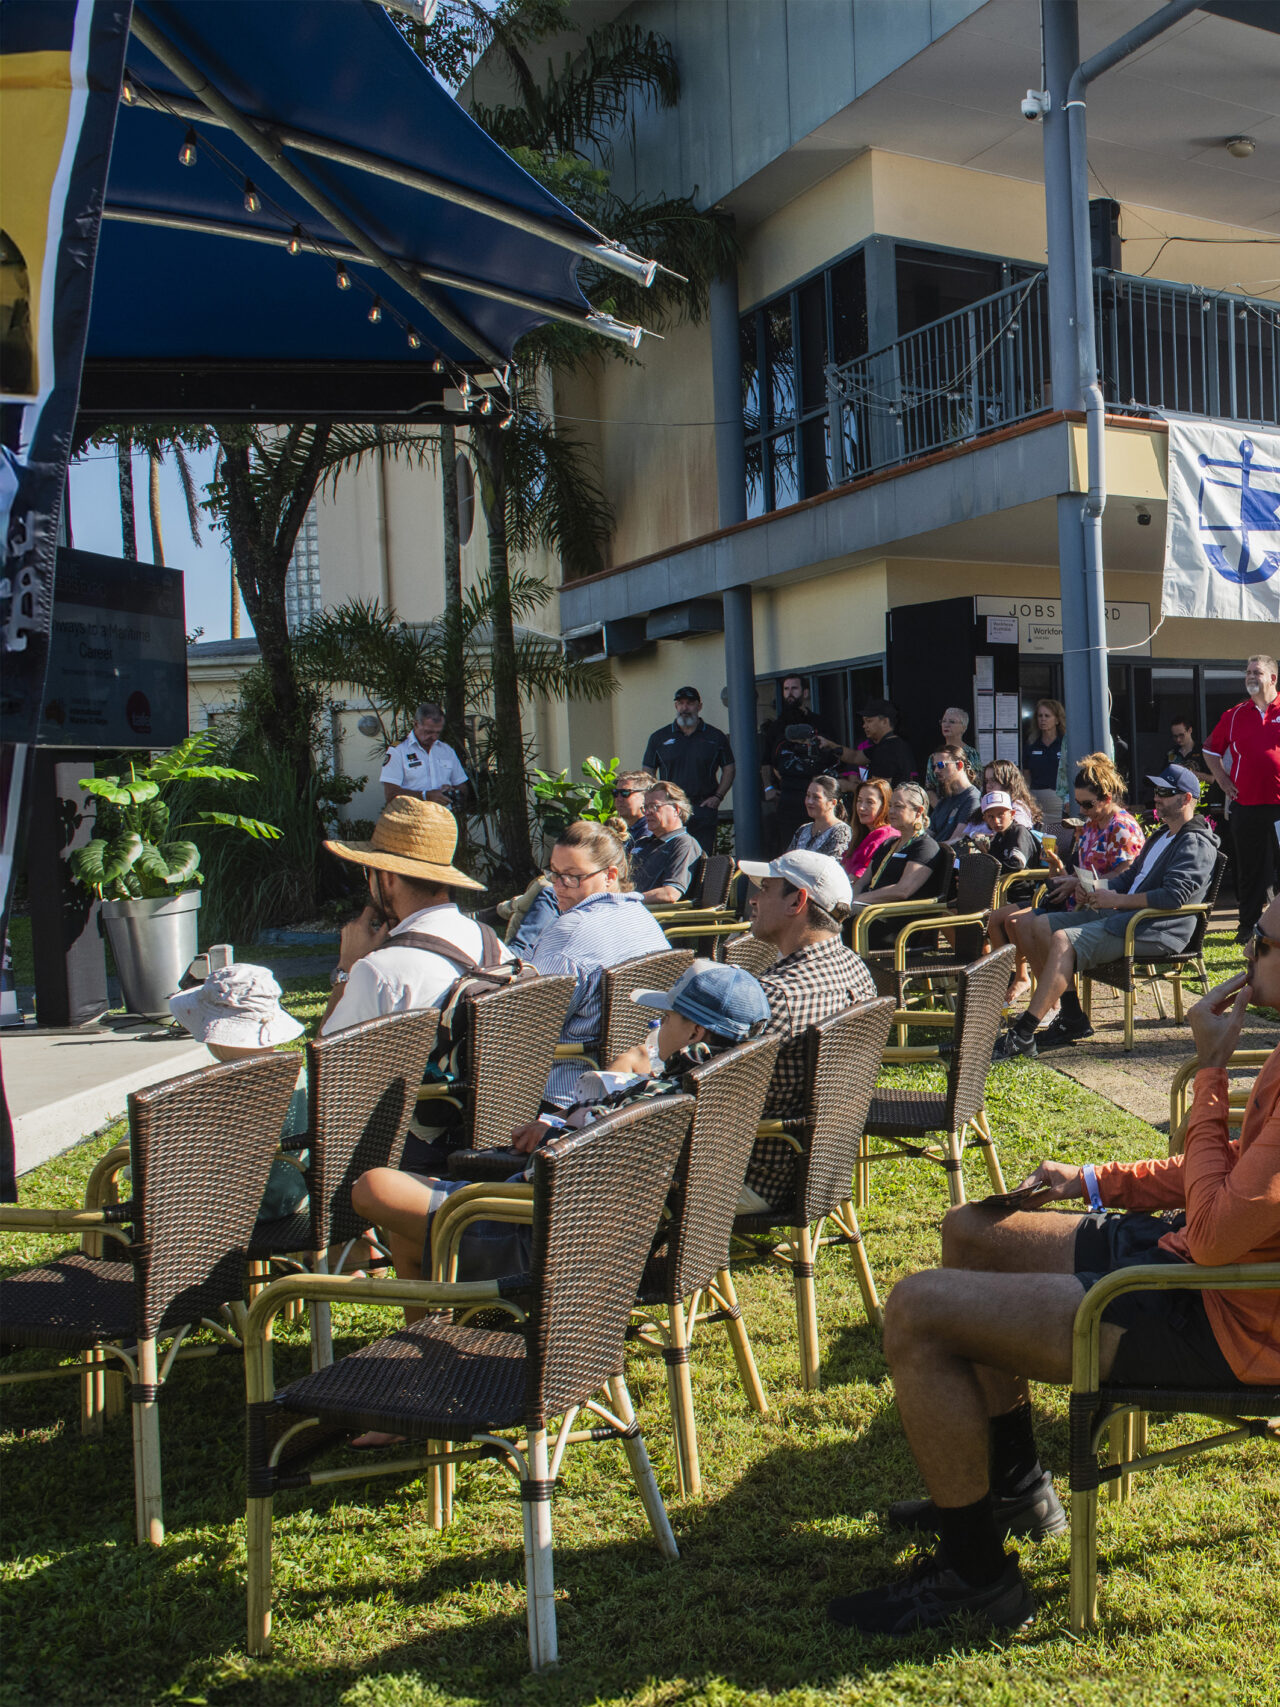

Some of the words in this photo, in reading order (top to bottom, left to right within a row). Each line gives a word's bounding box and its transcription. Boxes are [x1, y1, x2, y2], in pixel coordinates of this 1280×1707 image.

[1009, 603, 1056, 618] JOBS
[1033, 627, 1063, 635] Workfor
[79, 641, 113, 661] Career
